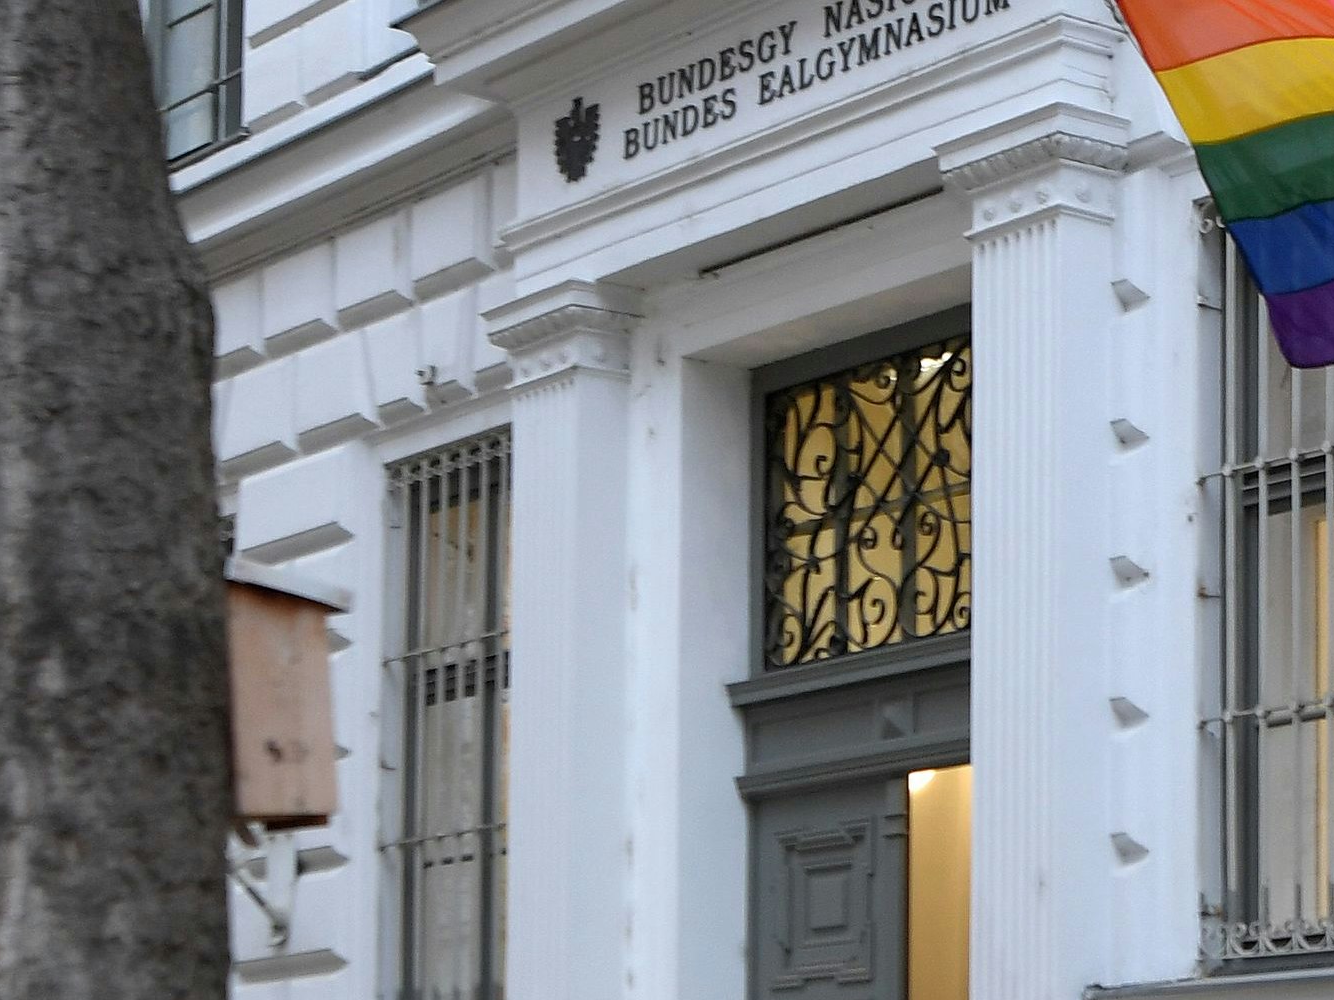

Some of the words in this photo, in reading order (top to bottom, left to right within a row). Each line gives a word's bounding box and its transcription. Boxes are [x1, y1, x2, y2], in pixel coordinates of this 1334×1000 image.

[637, 21, 798, 115] BUNDESGY
[823, 0, 915, 38] NAS
[623, 88, 737, 160] BUNDES
